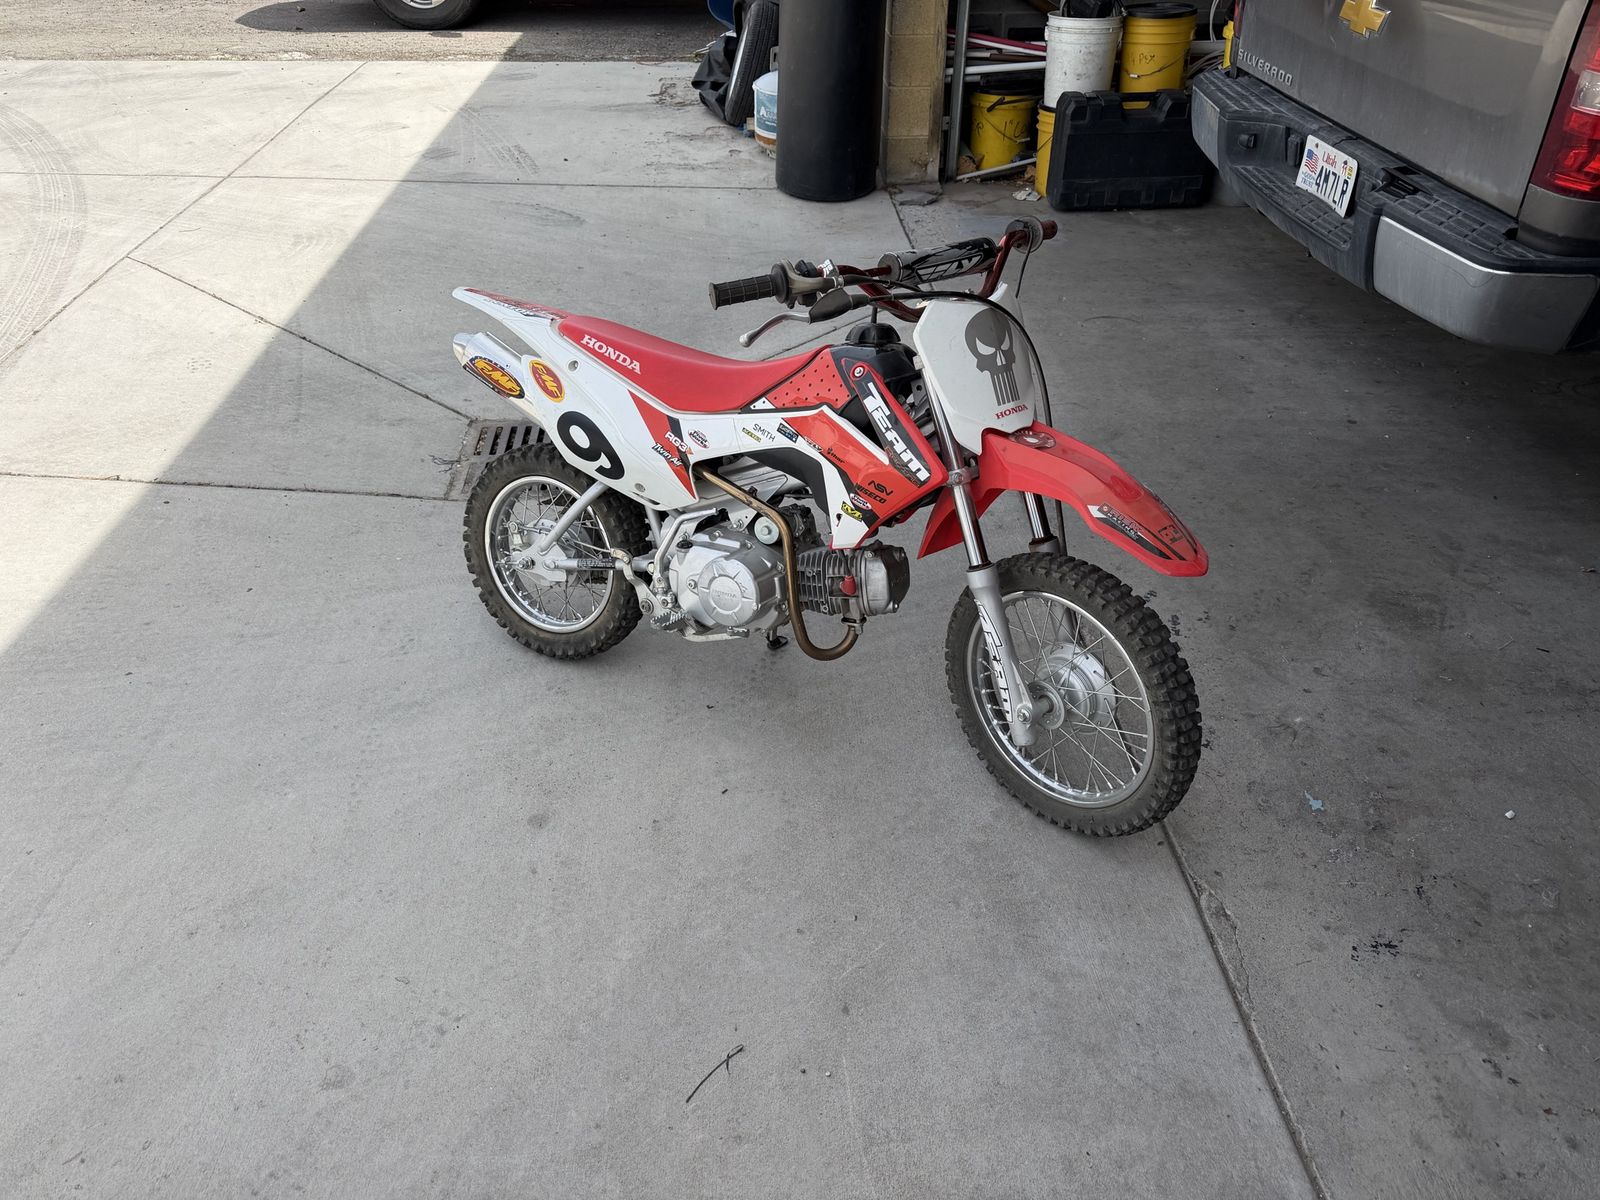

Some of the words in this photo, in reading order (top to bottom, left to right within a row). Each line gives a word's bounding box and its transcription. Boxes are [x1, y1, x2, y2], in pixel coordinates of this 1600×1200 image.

[1237, 48, 1294, 87] SILVERADO
[1322, 150, 1337, 168] Utah
[580, 334, 642, 375] HONDA
[474, 359, 521, 393] FMF
[532, 362, 562, 399] FMF
[995, 404, 1029, 420] HONDA
[557, 410, 626, 481] 9
[664, 431, 688, 452] RG3
[752, 423, 776, 443] SMITH
[863, 382, 931, 482] TEAM
[651, 442, 672, 459] Twin
[670, 456, 683, 467] Air
